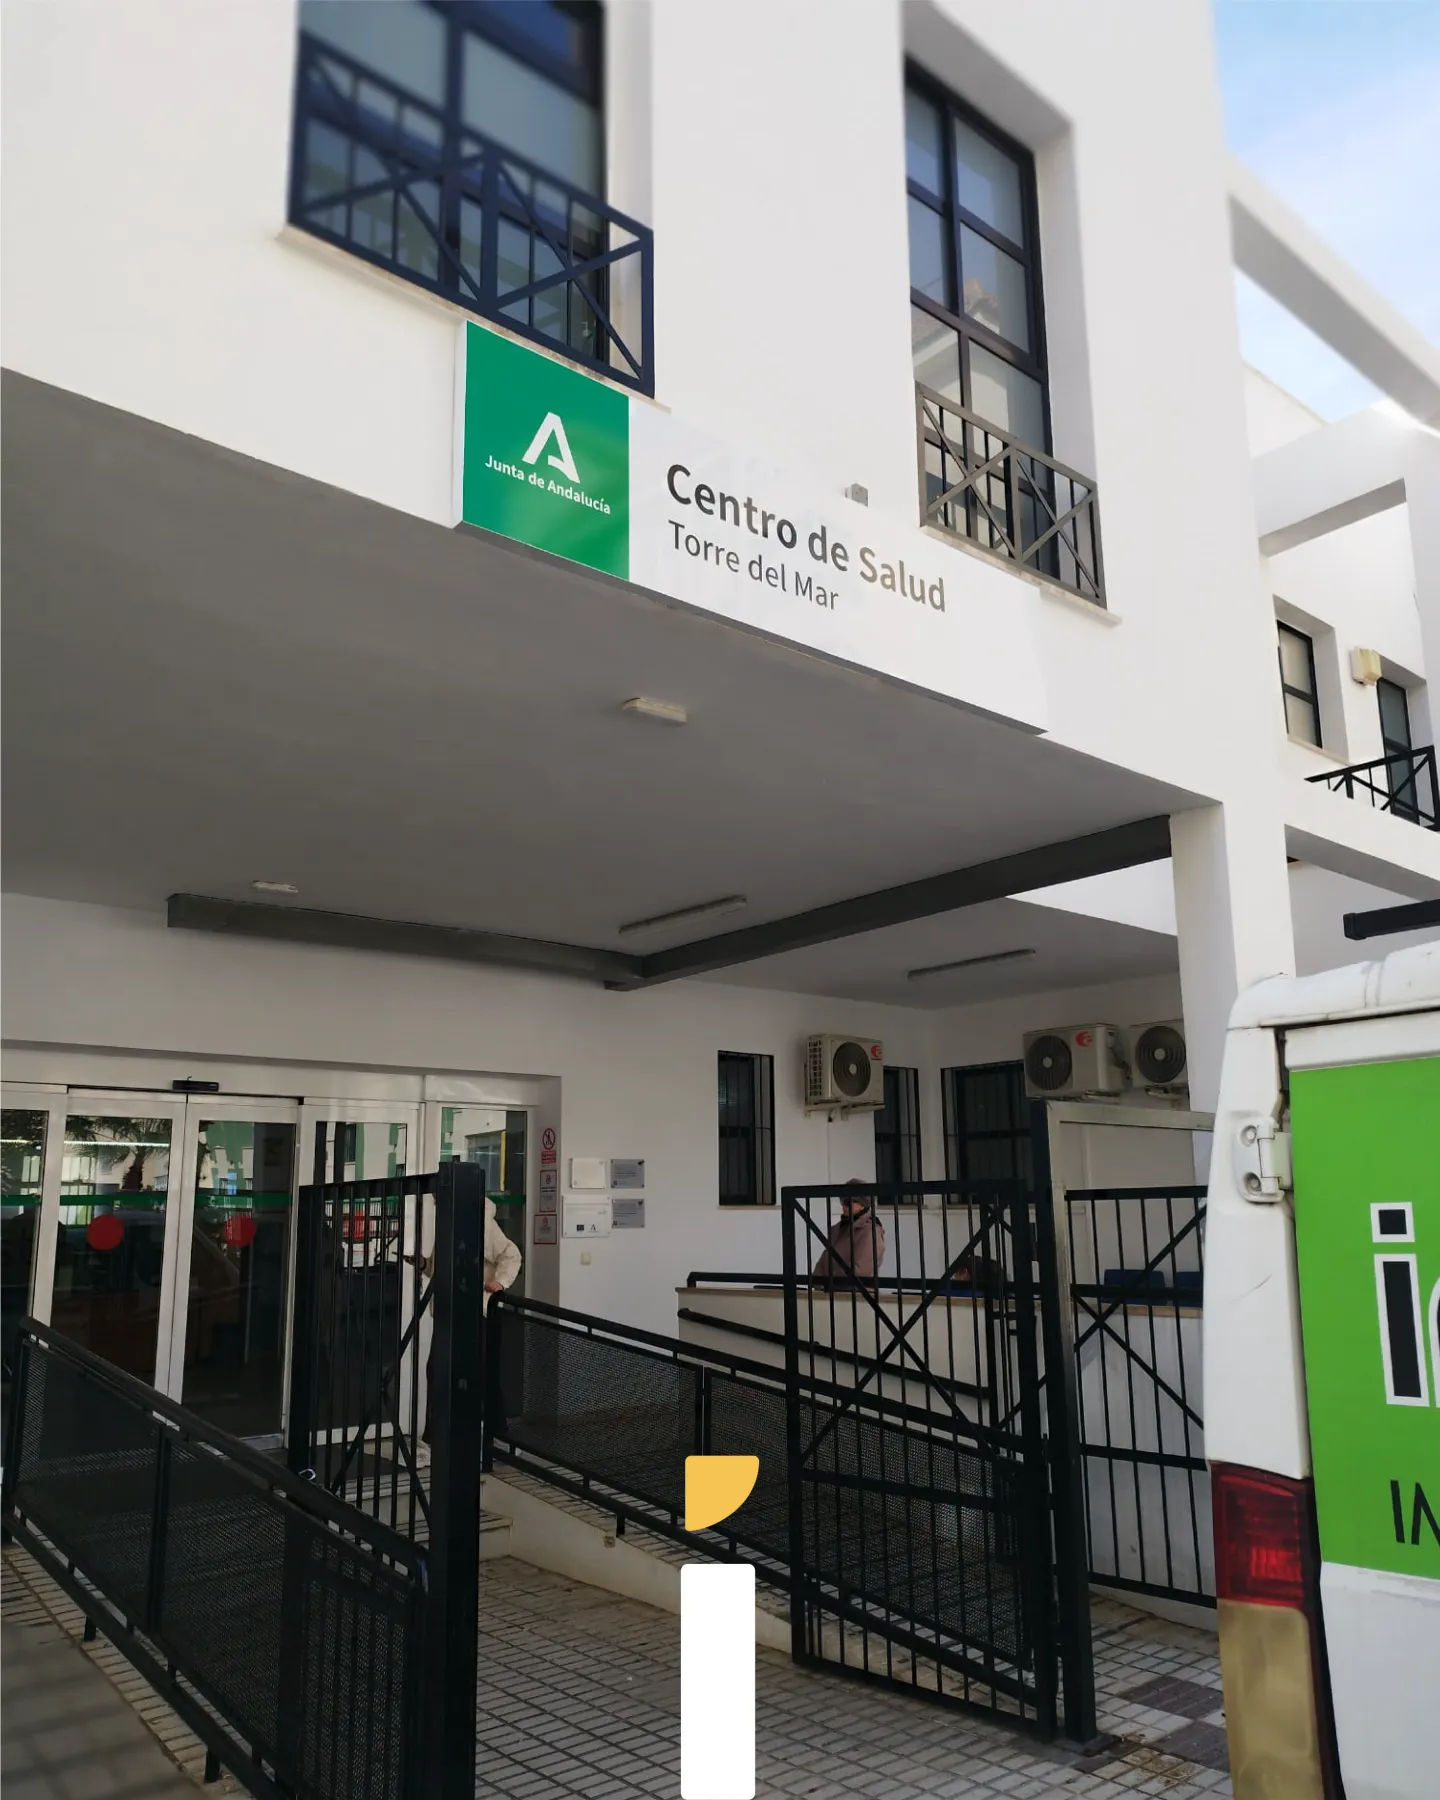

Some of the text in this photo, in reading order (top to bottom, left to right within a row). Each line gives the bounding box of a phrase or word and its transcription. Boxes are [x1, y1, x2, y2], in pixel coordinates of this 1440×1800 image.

[485, 455, 611, 515] Junta de Andalucía
[667, 464, 946, 612] Centro de Salud
[668, 519, 839, 610] Torre del Mar
[1370, 1202, 1440, 1408] i
